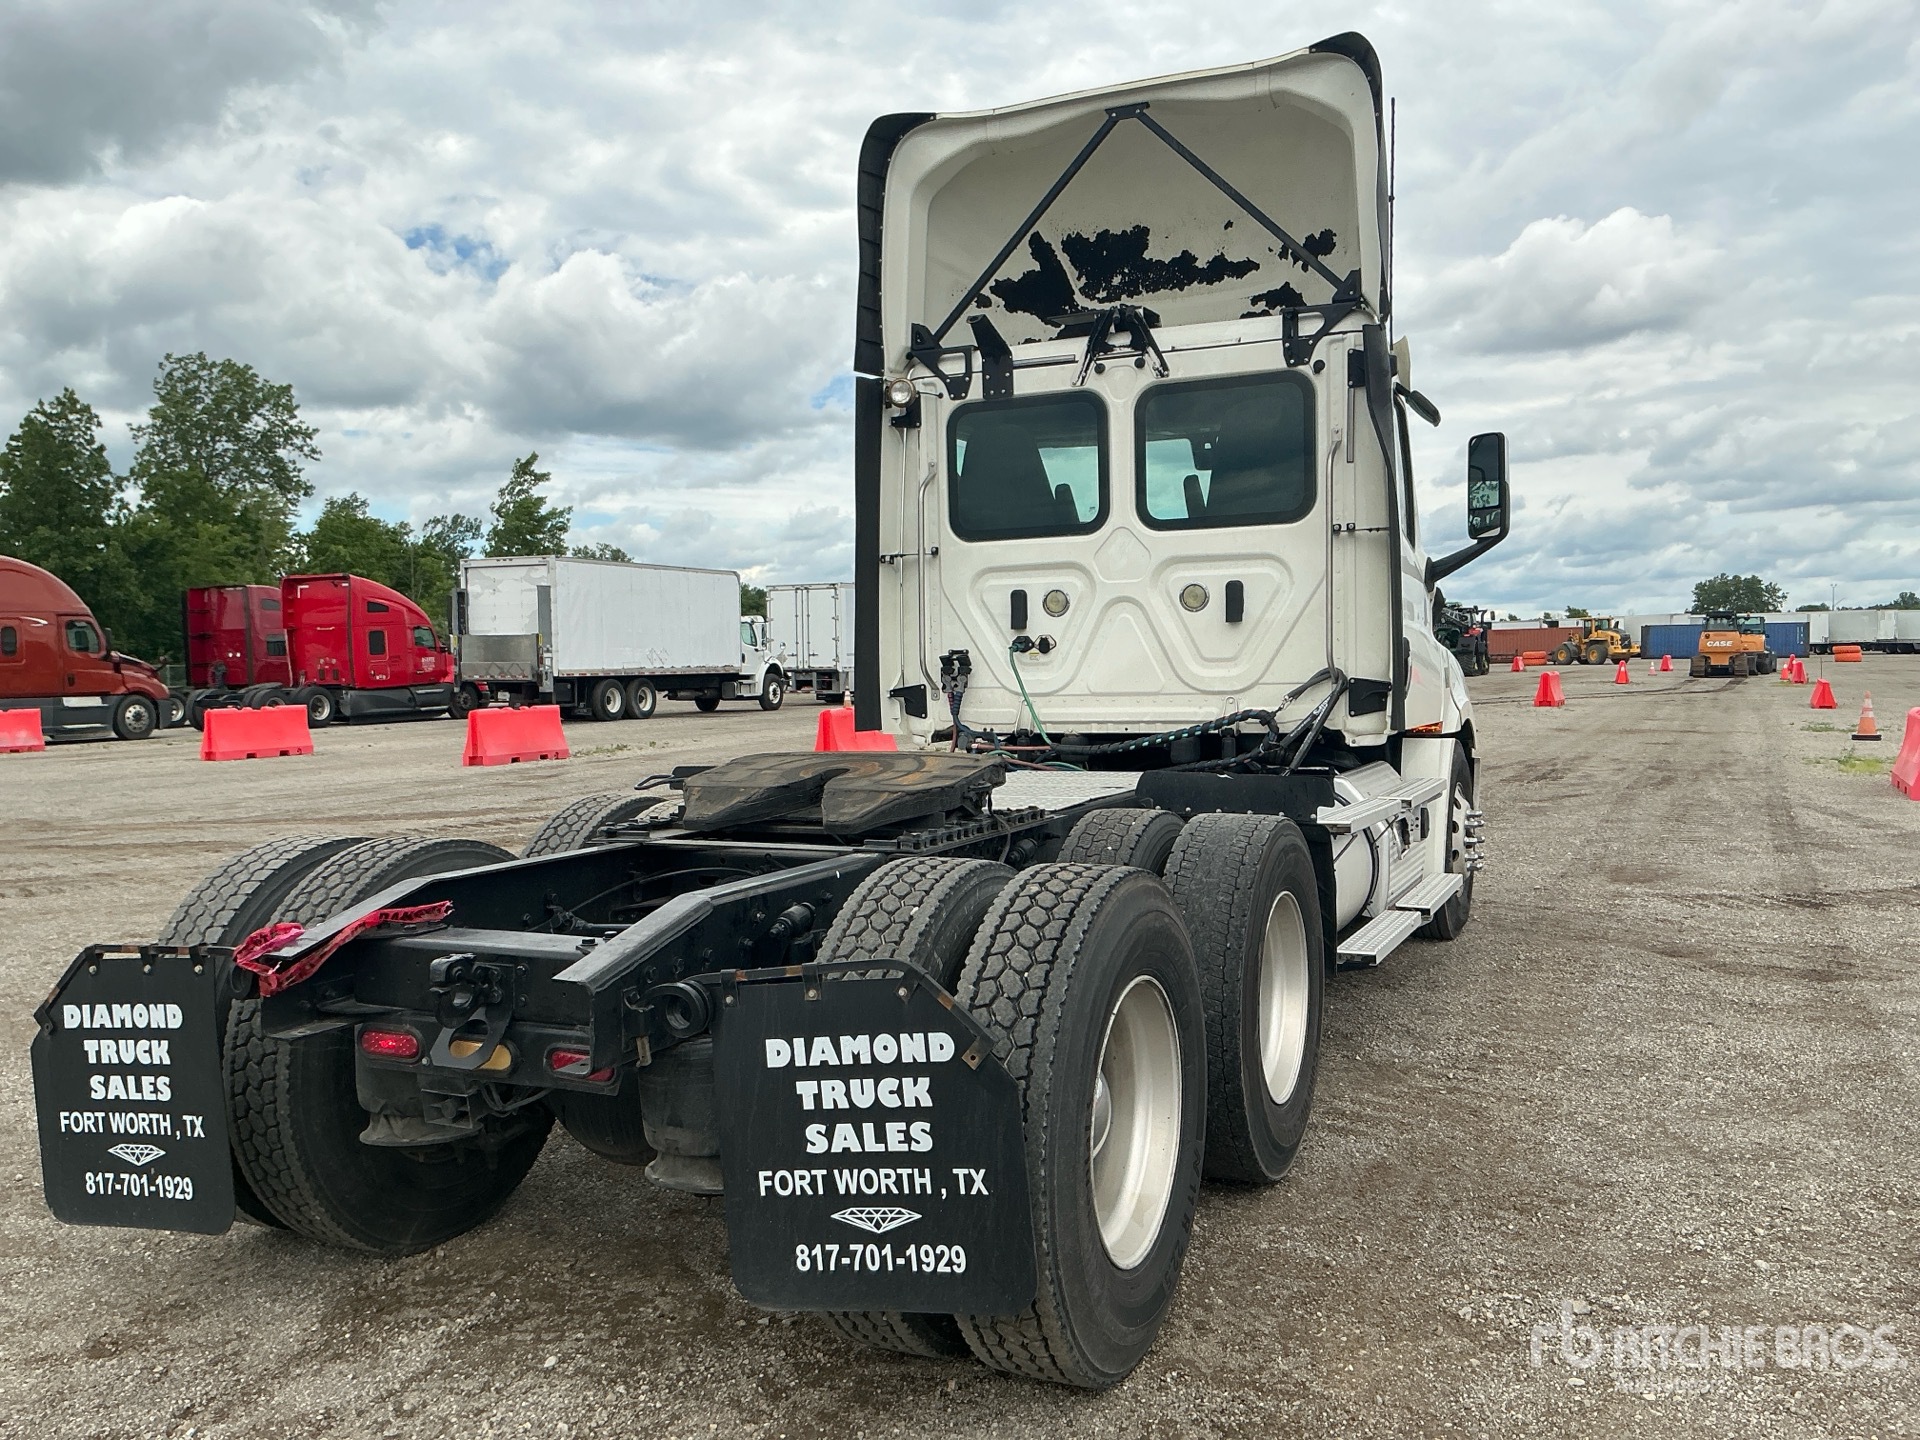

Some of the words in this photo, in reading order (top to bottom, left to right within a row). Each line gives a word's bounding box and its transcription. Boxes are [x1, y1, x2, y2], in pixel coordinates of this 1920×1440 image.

[63, 1003, 183, 1029] DIAMOND
[84, 1040, 171, 1065] TRUCK
[765, 1032, 955, 1068] DIAMOND
[90, 1075, 172, 1102] SALES
[796, 1077, 933, 1110] TRUCK
[60, 1111, 105, 1133] FORT
[109, 1112, 172, 1136] WORTH
[183, 1115, 206, 1138] TX
[805, 1122, 933, 1154] SALES
[85, 1171, 193, 1200] 817-701-1929
[759, 1170, 827, 1196] FORT
[833, 1168, 932, 1194] WORTH
[953, 1169, 989, 1195] TX
[795, 1244, 967, 1273] 817-701-1929
